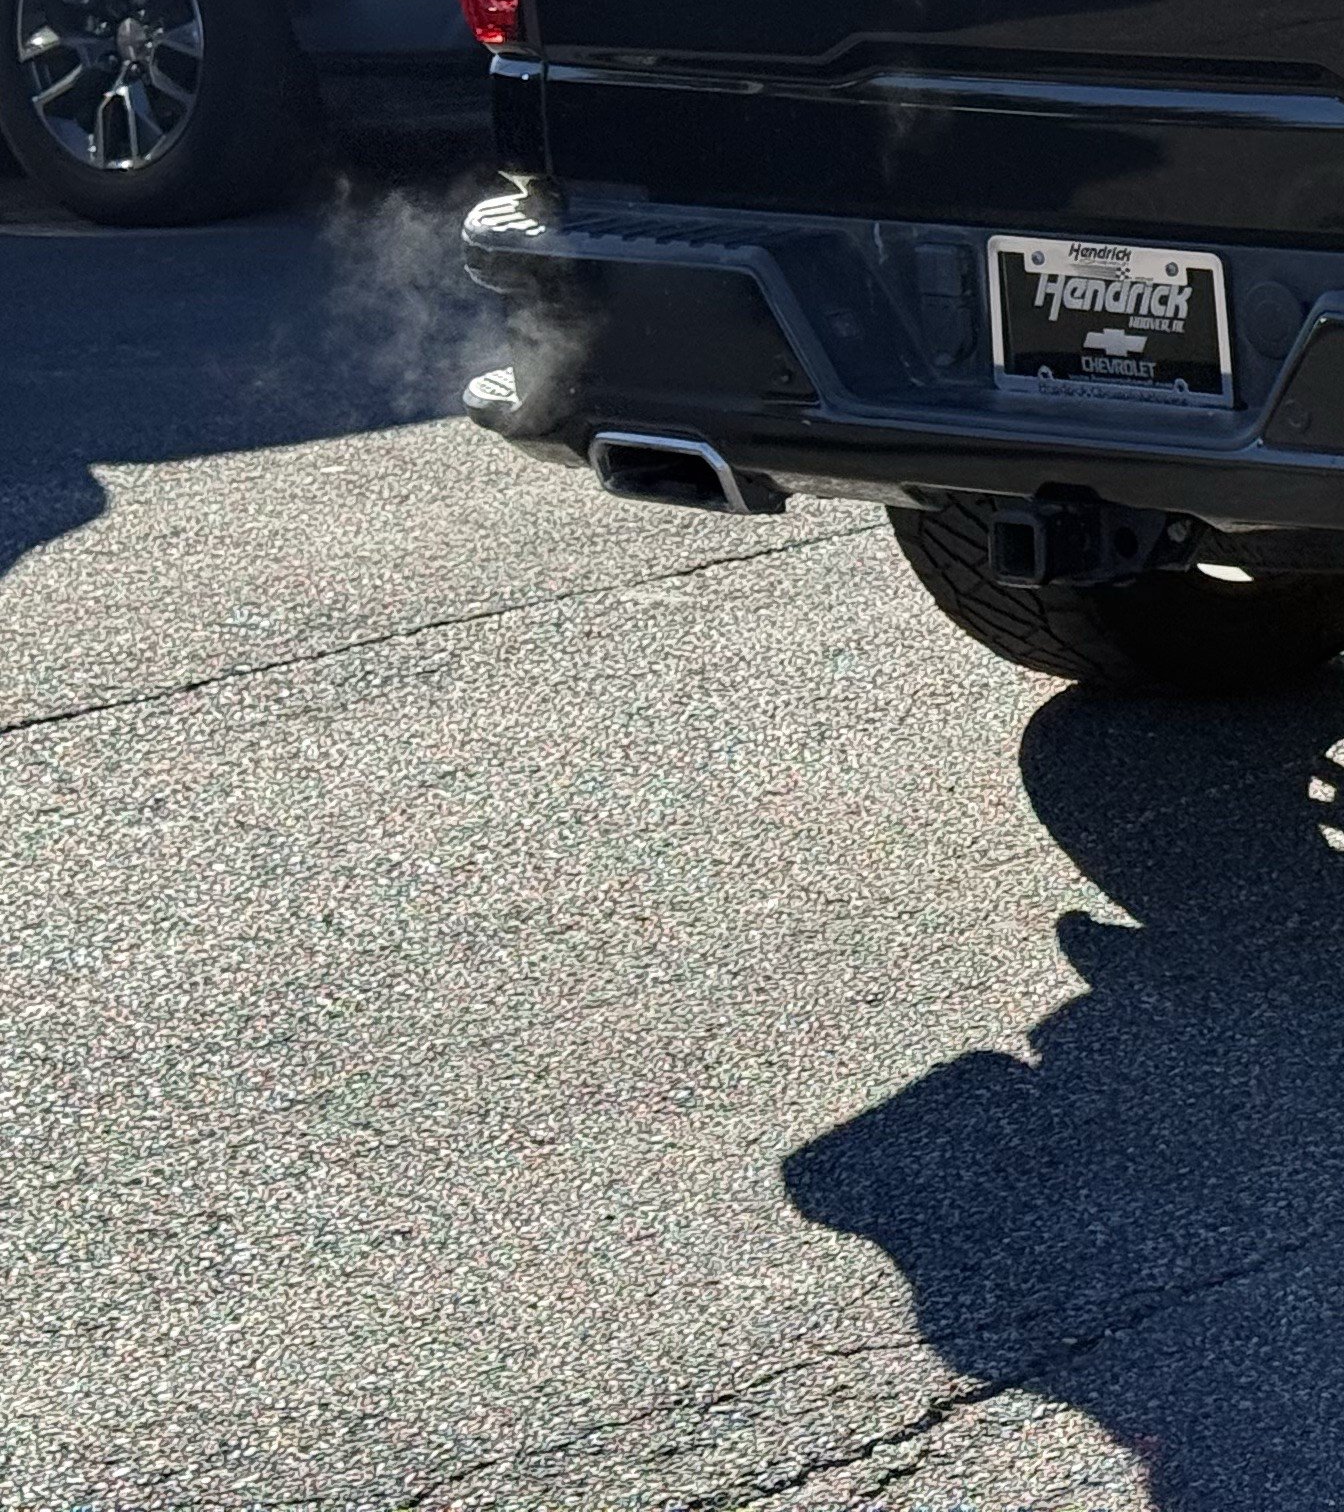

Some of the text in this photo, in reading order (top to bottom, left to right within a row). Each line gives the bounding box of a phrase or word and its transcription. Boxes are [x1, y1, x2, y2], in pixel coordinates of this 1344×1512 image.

[1068, 241, 1132, 262] Hendrick
[1034, 273, 1193, 322] Hendrick
[1081, 355, 1157, 379] CHEVROLET
